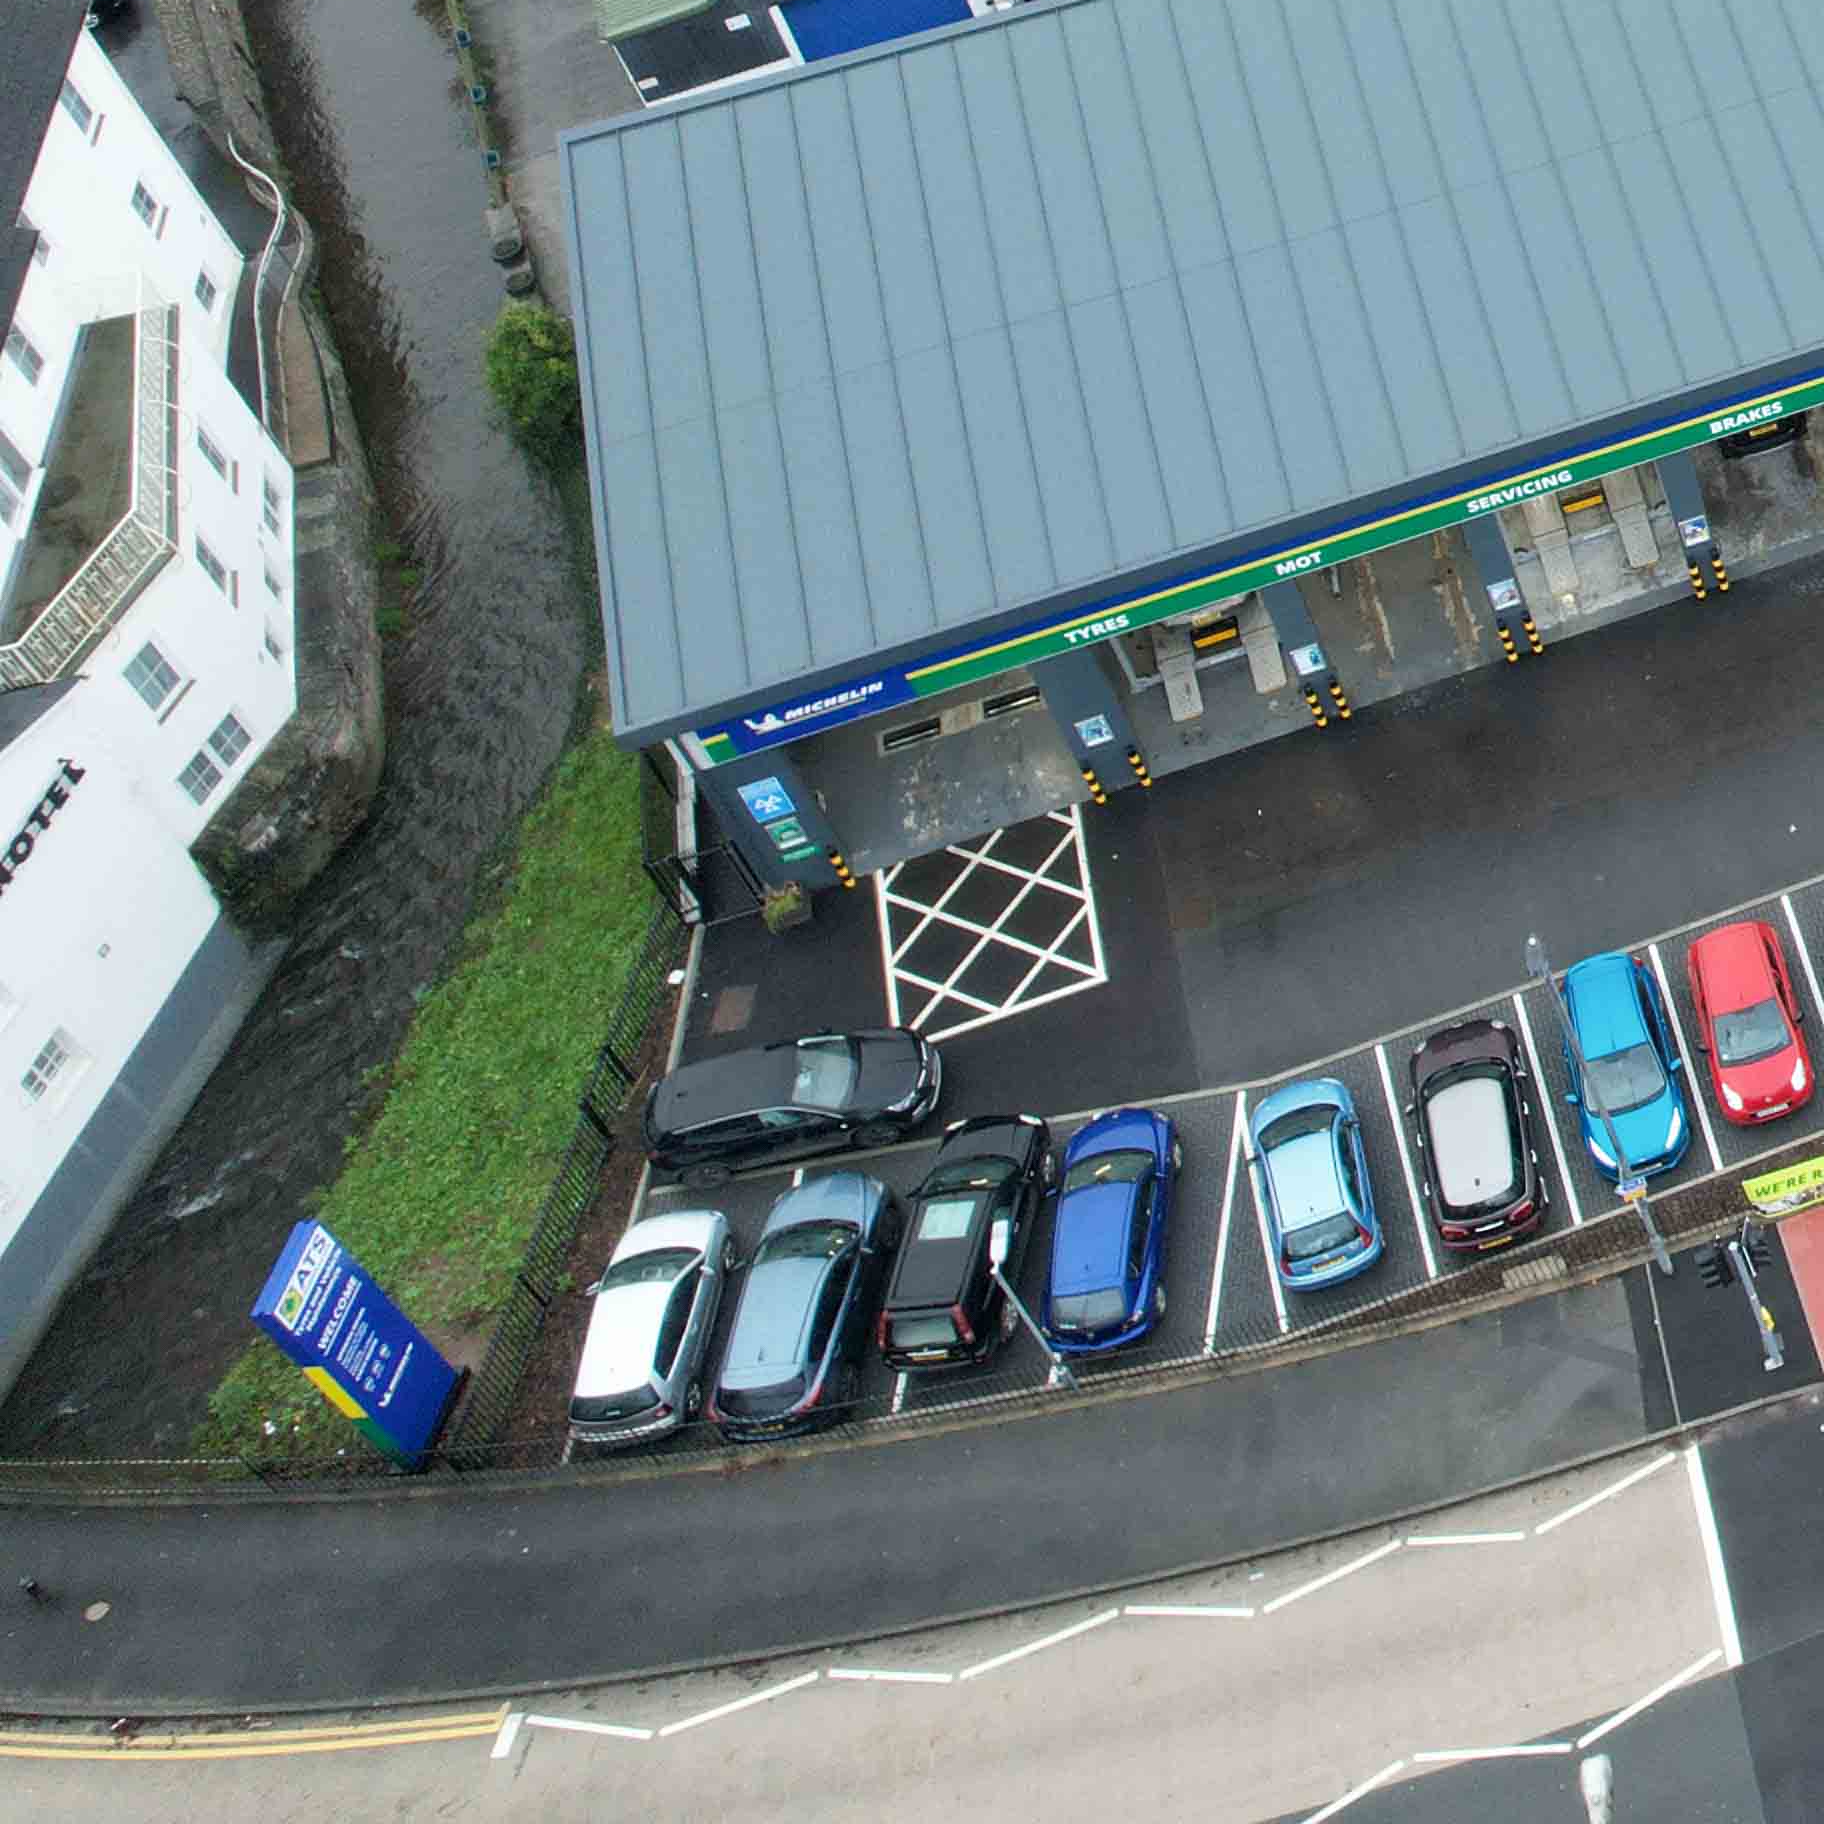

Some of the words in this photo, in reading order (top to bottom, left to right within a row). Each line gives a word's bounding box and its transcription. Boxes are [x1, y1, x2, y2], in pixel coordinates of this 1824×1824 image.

[1709, 400, 1784, 435] BRAKES
[1466, 469, 1573, 514] SERVICING
[1273, 550, 1323, 577] MOT
[1063, 614, 1130, 644] TYRES
[784, 680, 884, 721] MICHELIN
[1754, 1175, 1808, 1199] WE'RE
[294, 1235, 327, 1293] ATS
[317, 1275, 358, 1351] WELCOME
